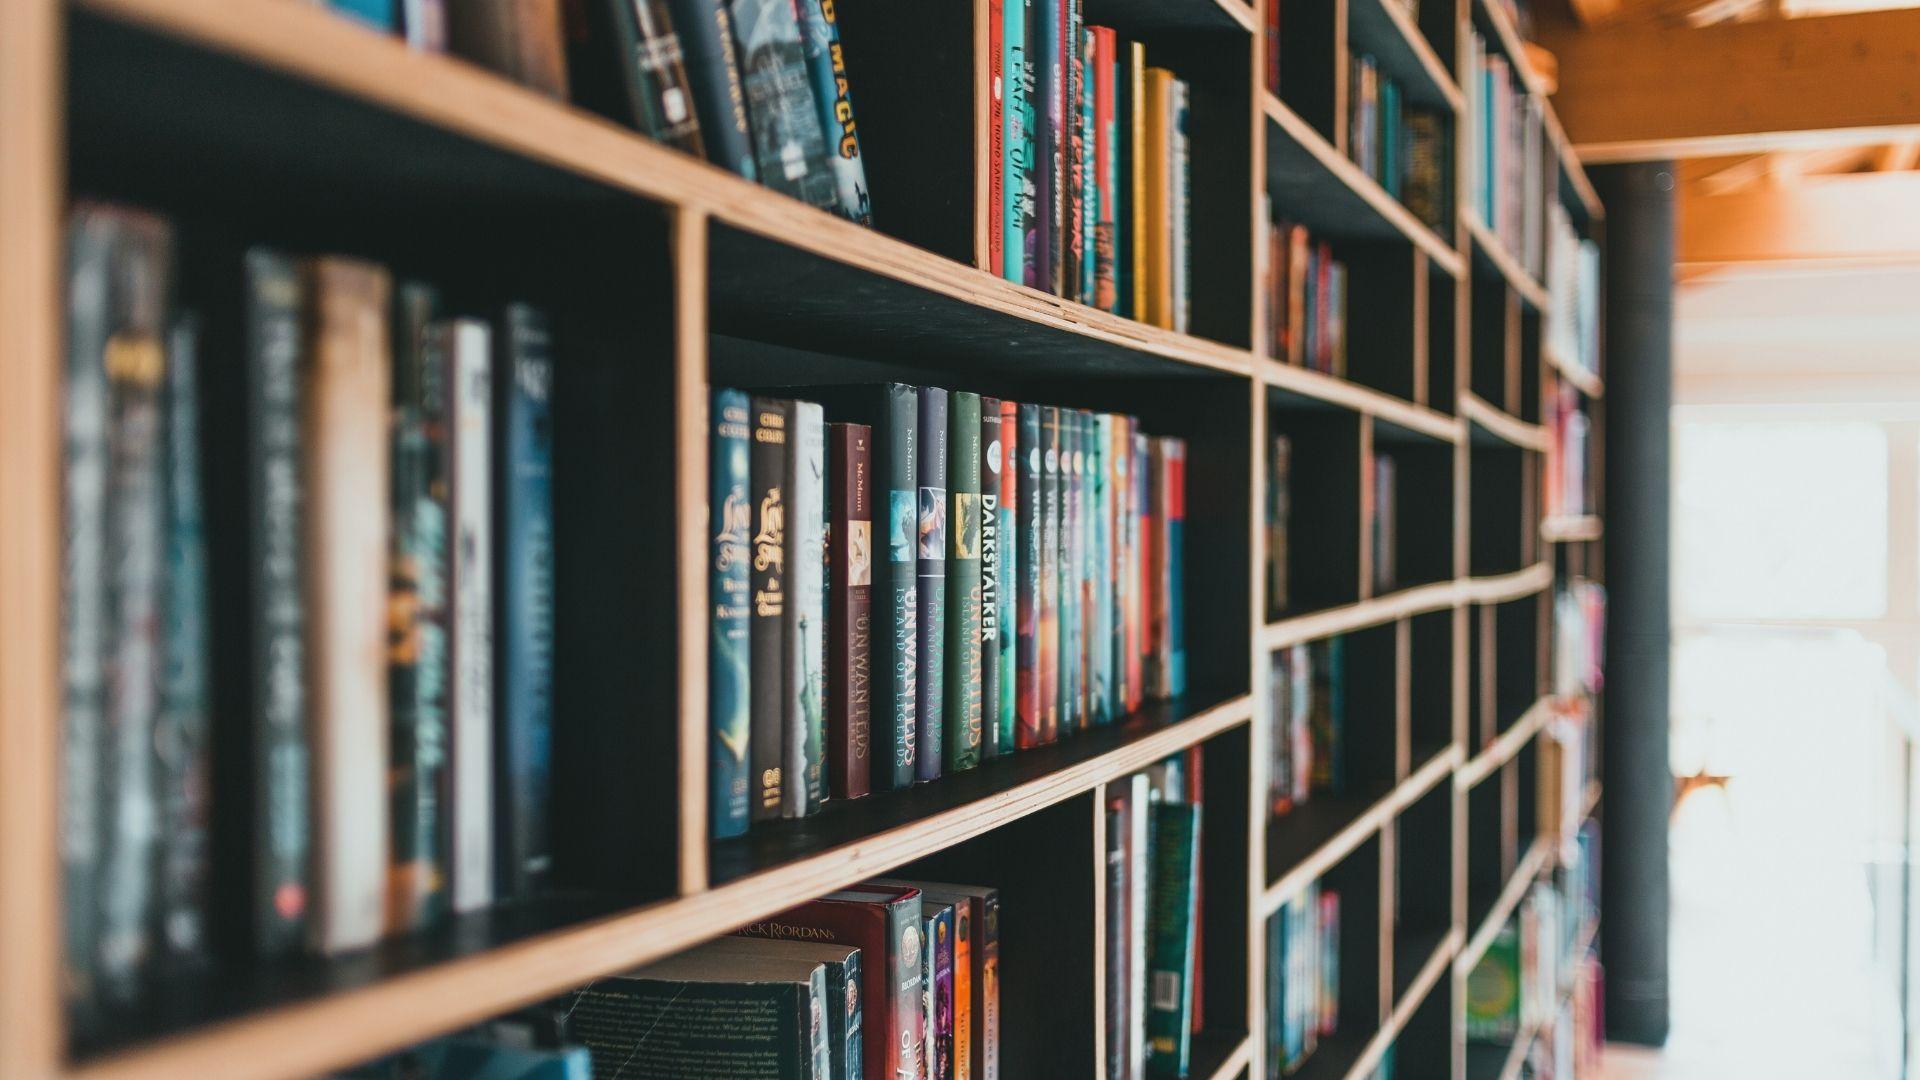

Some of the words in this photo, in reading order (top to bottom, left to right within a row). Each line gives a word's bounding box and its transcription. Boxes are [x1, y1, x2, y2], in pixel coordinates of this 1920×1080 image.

[829, 42, 858, 160] MAGIC
[1072, 135, 1083, 187] LOVE
[1070, 196, 1083, 260] STORY
[982, 494, 997, 642] DARKSTALKER
[896, 588, 904, 650] ISLAND
[856, 617, 869, 760] UNWANTEDS
[896, 662, 904, 682] OF
[904, 590, 916, 767] UNWANTEDS
[928, 660, 935, 674] OF
[896, 692, 904, 768] LEGENDS
[960, 674, 969, 736] DRAGONS
[901, 973, 921, 992] RIORDAN
[901, 1030, 911, 1059] OF
